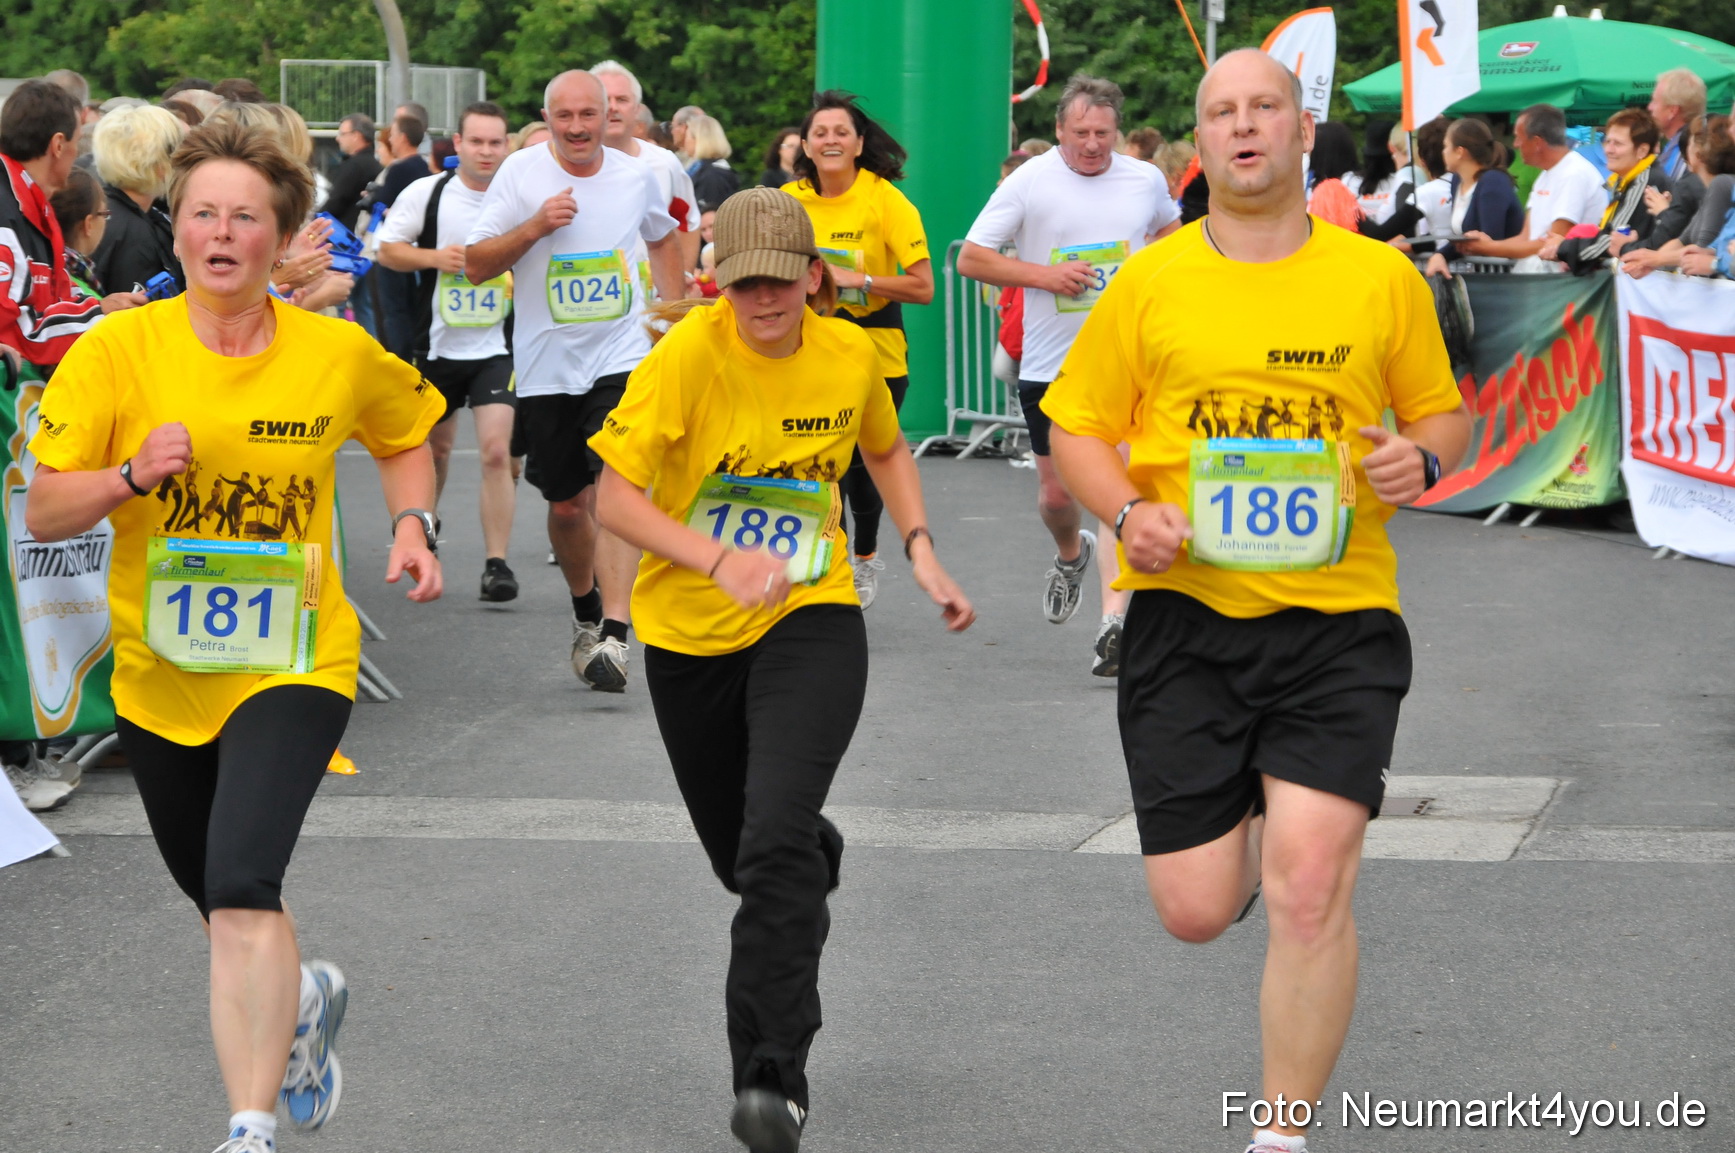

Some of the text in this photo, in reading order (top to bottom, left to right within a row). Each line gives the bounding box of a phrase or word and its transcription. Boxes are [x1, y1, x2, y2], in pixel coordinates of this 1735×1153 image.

[830, 231, 854, 240] swn
[551, 275, 622, 304] 1024
[448, 288, 497, 312] 314
[1266, 350, 1326, 364] swn
[248, 419, 307, 437] swn
[782, 417, 831, 431] swn
[247, 436, 320, 446] stadtwerke neumarkt
[1210, 484, 1319, 537] 186
[707, 503, 803, 560] 188
[1216, 539, 1281, 551] Johannes
[170, 566, 226, 577] firmenlauf
[166, 584, 273, 639] 181
[190, 639, 226, 651] Petra
